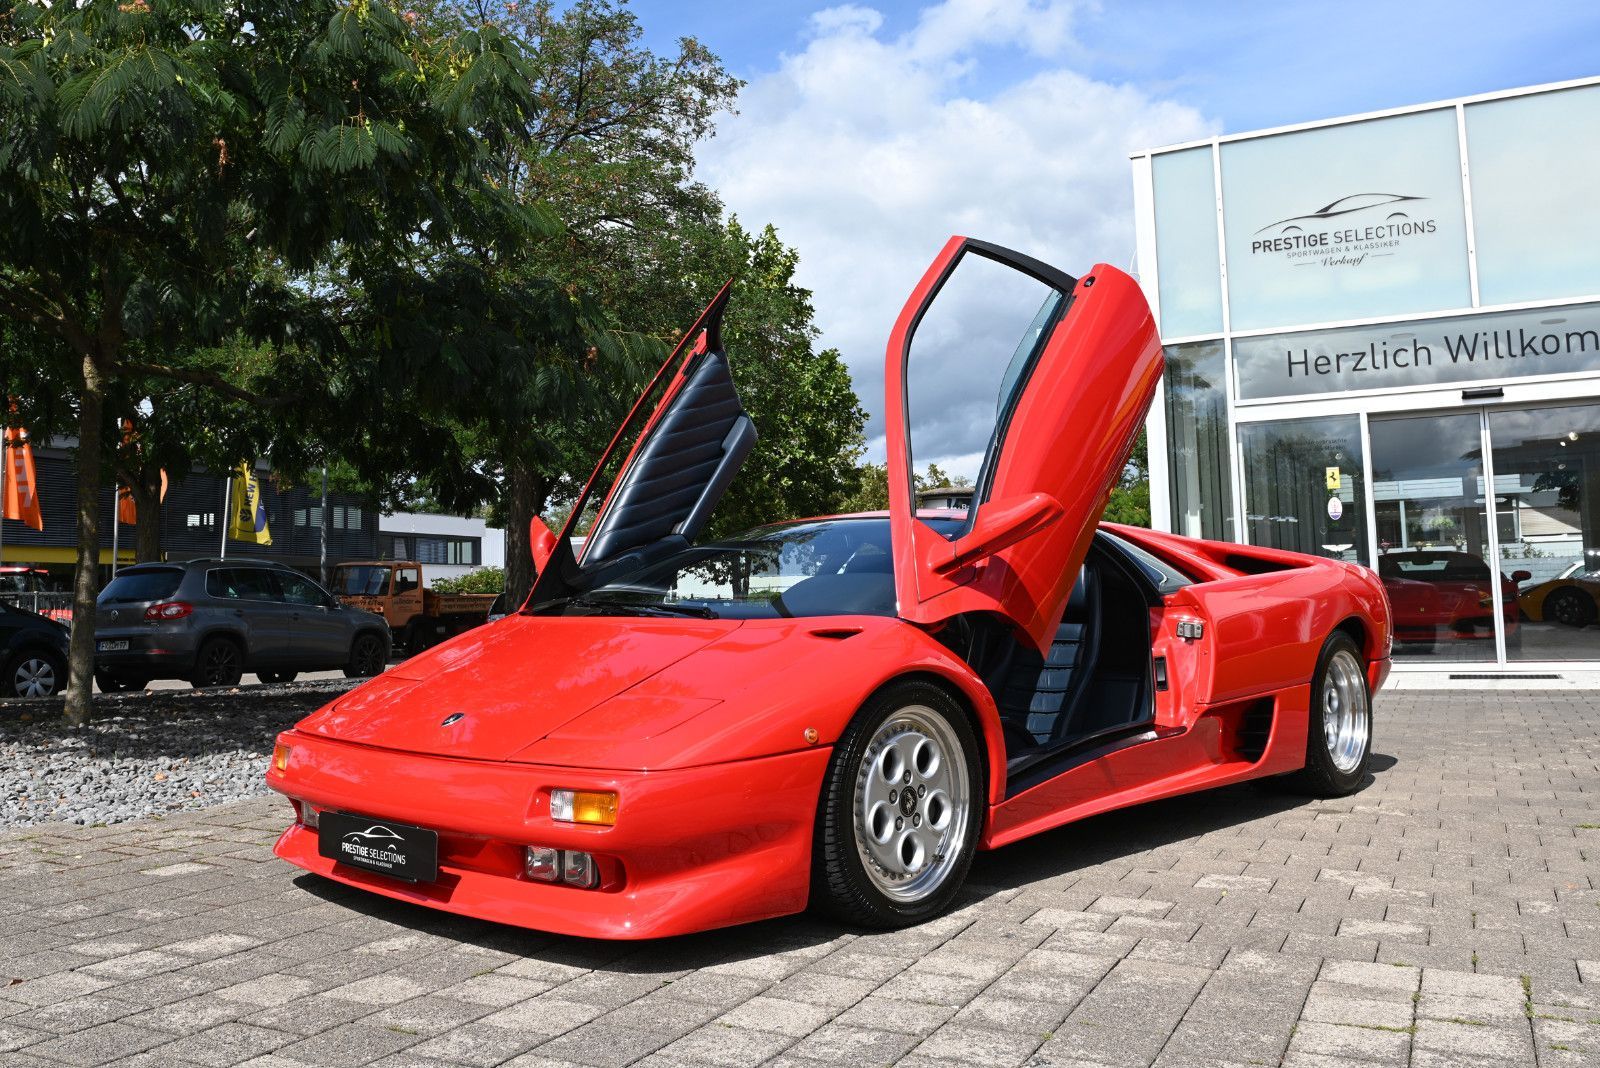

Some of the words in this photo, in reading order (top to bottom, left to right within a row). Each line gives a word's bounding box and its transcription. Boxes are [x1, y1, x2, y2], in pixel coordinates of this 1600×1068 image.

[1252, 233, 1329, 254] PRESTIGE
[1334, 220, 1437, 244] SELECTIONS
[1286, 247, 1342, 259] SPORTWAGEN
[1354, 240, 1400, 251] KLASSIKER
[1321, 252, 1368, 267] Verkauf
[1287, 339, 1432, 377] Herzlich
[1444, 328, 1600, 363] Willkom
[244, 483, 256, 506] NEW
[342, 842, 369, 857] PRESTIGE
[369, 848, 406, 865] SELECTIONS
